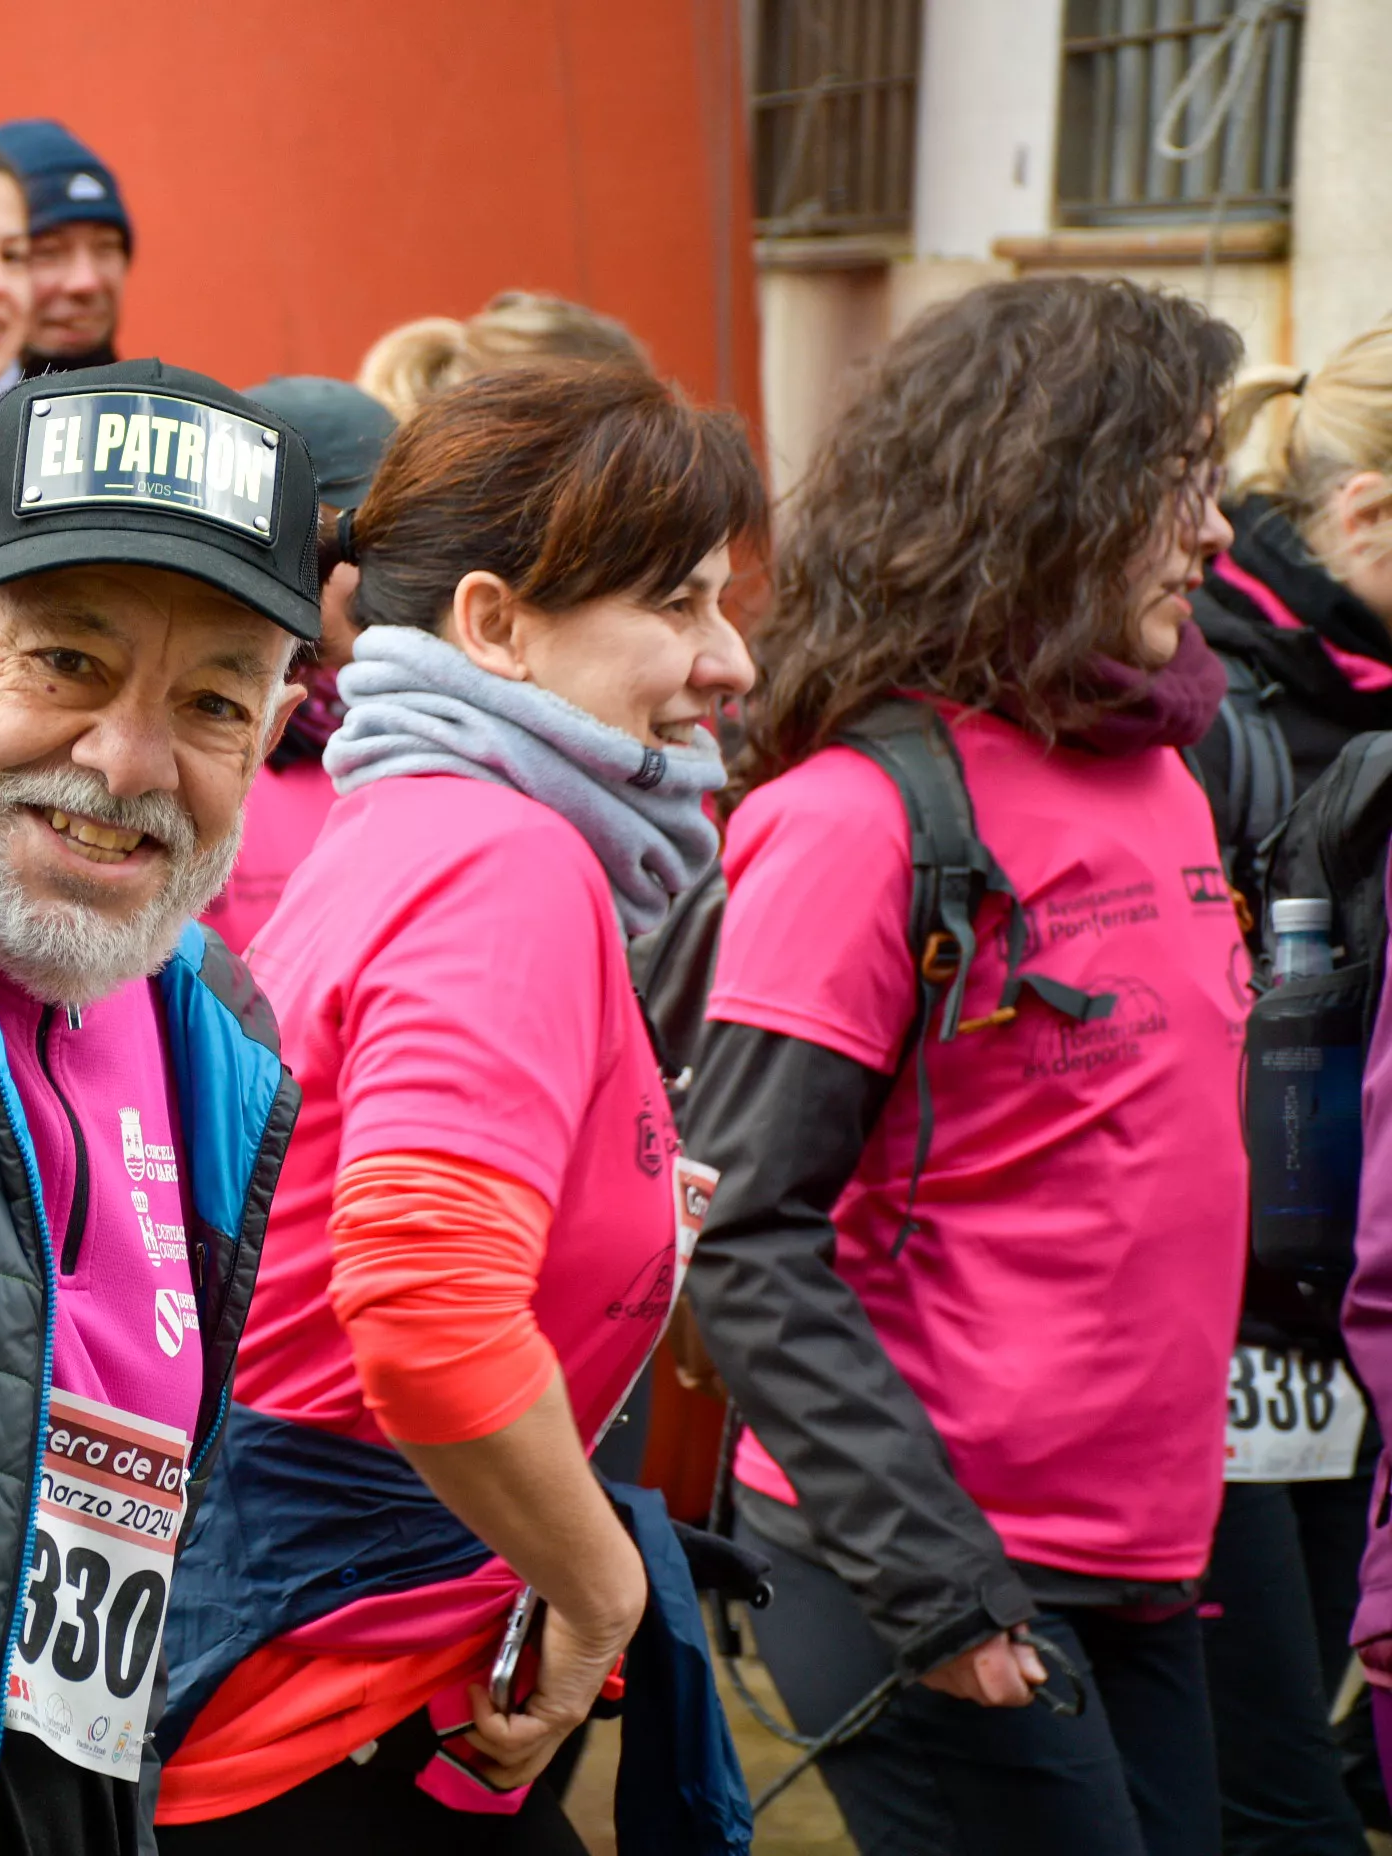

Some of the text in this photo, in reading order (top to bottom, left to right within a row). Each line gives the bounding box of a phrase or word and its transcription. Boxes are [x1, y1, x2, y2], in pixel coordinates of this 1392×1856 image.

[40, 412, 265, 505] EL PATRÓN
[1048, 901, 1160, 942] Ponferrada
[1227, 1347, 1335, 1433] 338
[113, 1447, 152, 1481] de
[155, 1458, 181, 1491] la
[116, 1499, 174, 1538] 2024
[16, 1528, 166, 1699] 330
